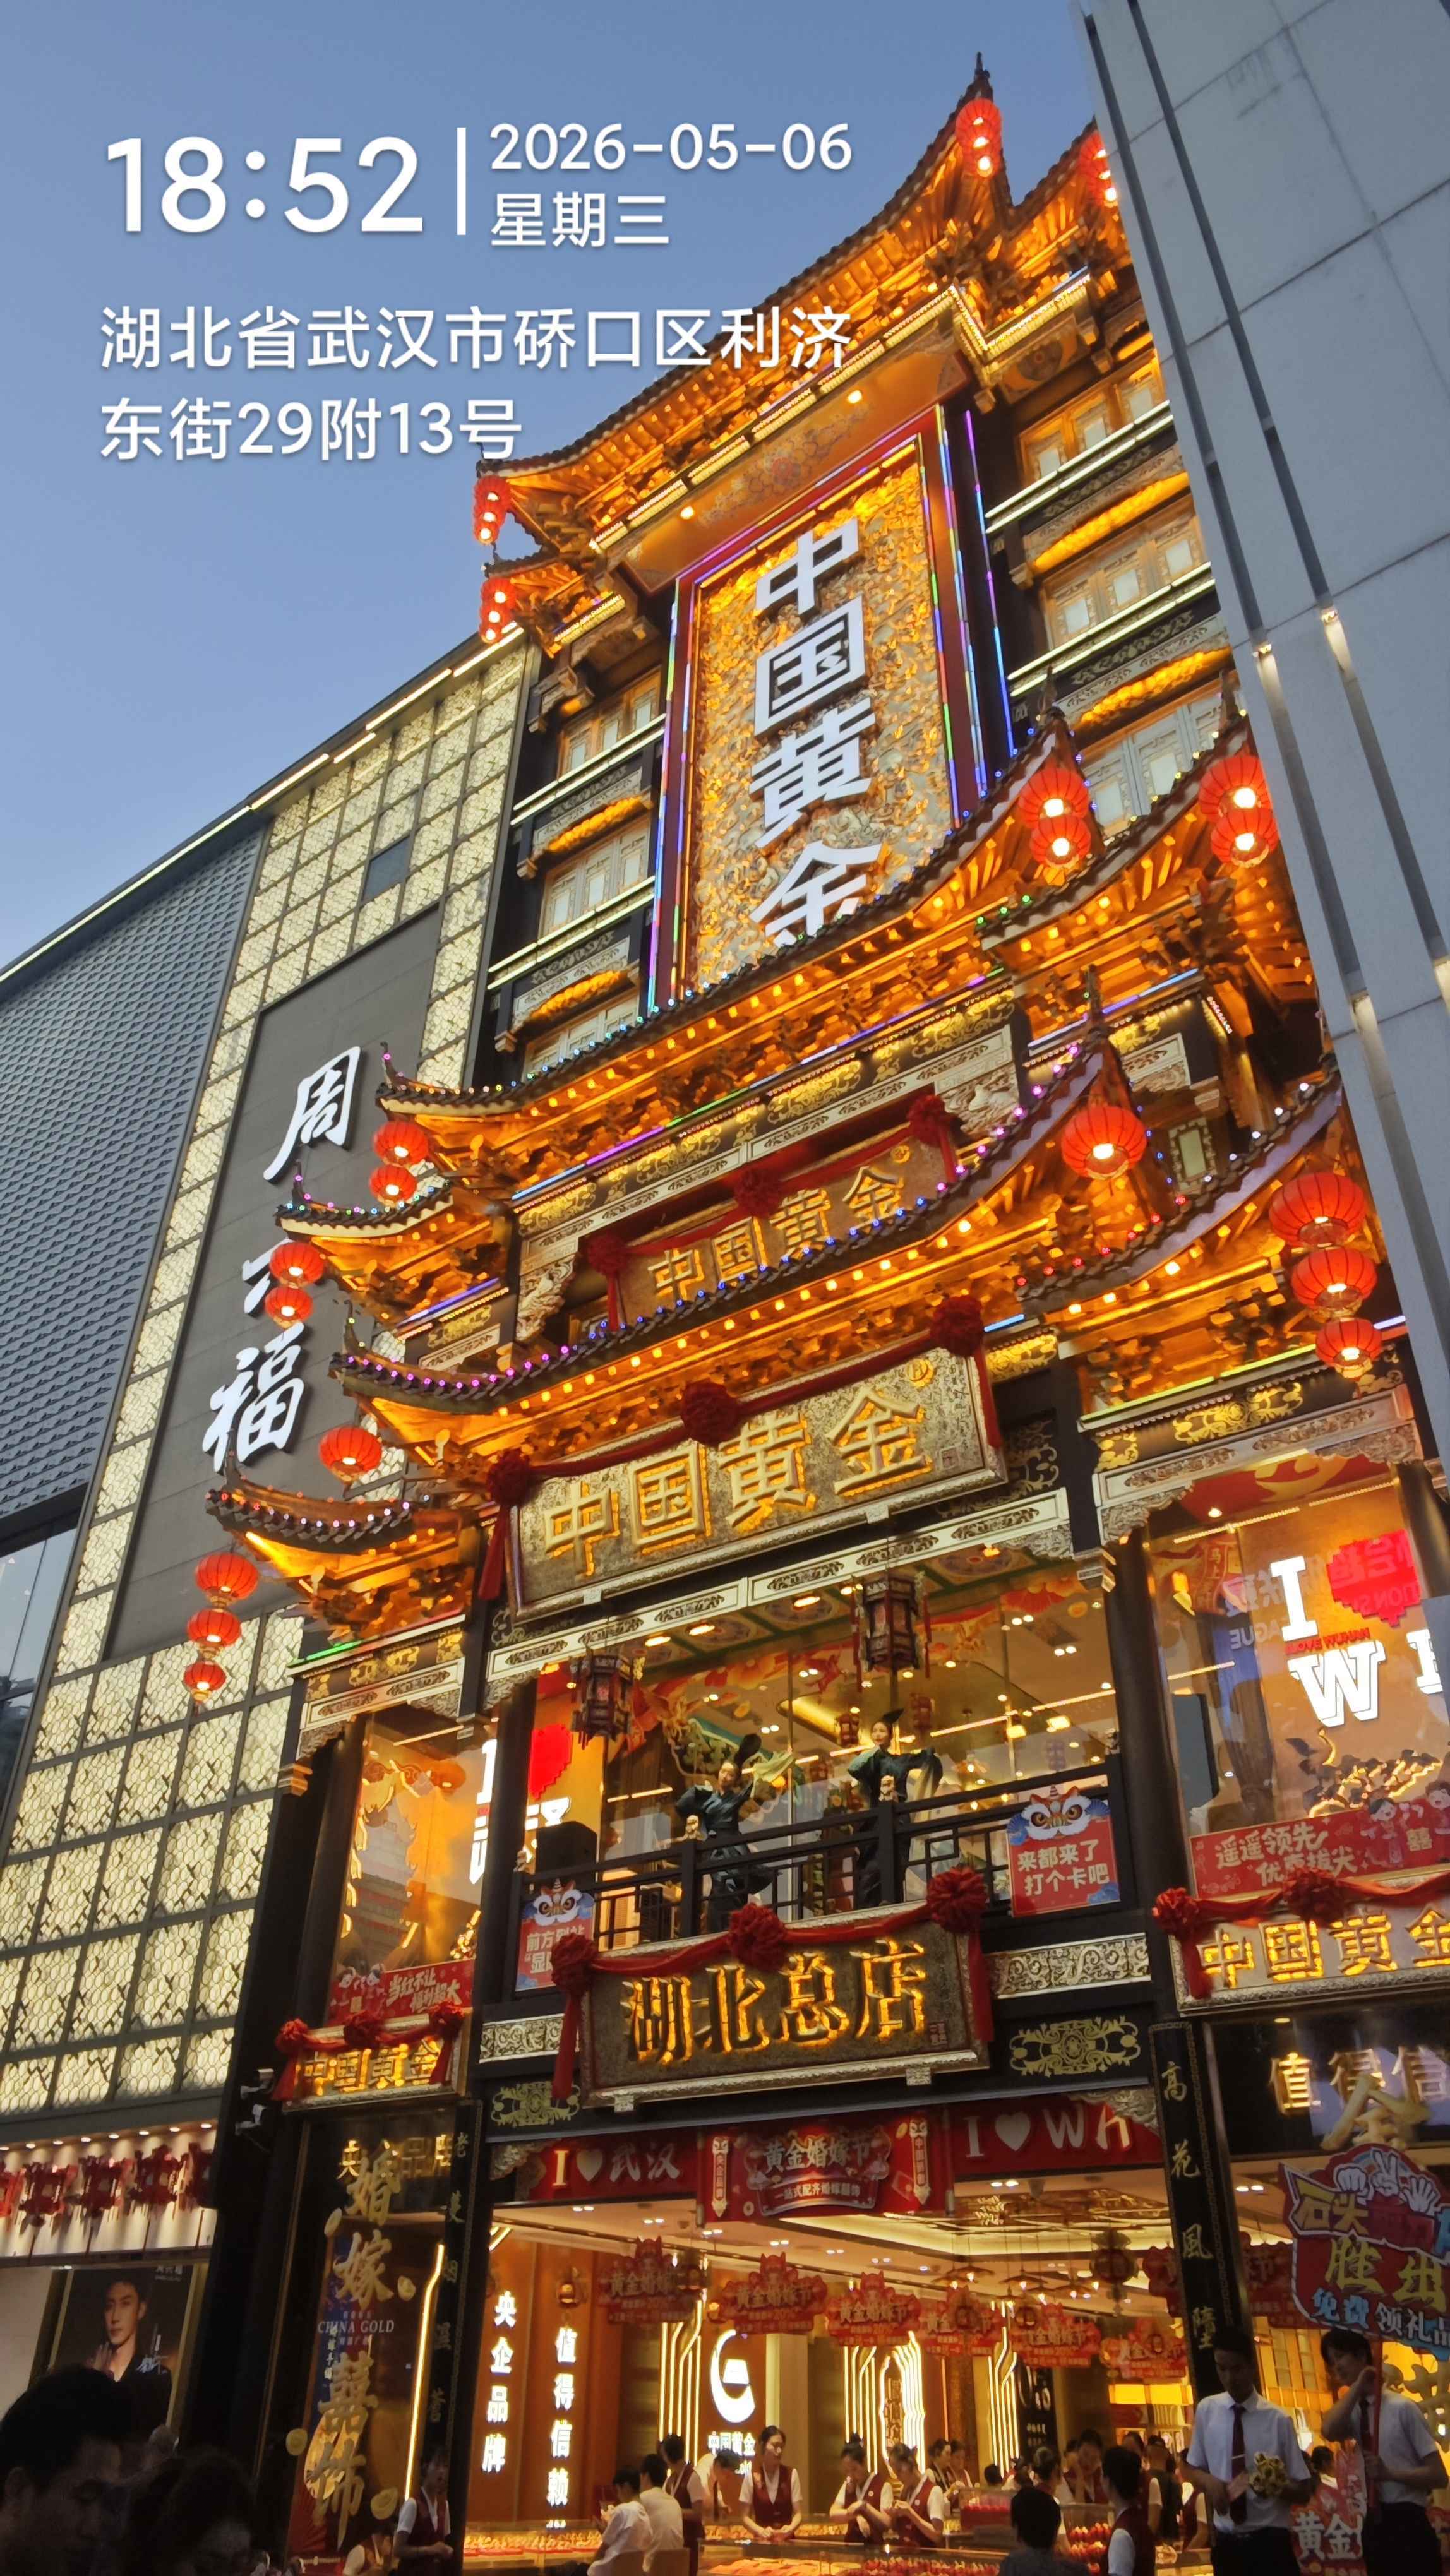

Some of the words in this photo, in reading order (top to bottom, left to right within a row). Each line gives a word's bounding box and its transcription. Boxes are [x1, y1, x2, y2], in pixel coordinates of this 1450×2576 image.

[750, 518, 882, 945] 中国黄金
[203, 1046, 361, 1472] 周福
[647, 1166, 904, 1302] 中国黄金
[544, 1386, 933, 1578] 中国黄金
[1017, 1838, 1099, 1873] 来都来了
[1024, 1863, 1110, 1897] 打个卡吧
[1214, 1822, 1328, 1869] 遥遥领先
[1197, 1903, 1450, 1989] 中国黄金
[621, 1938, 926, 2065] 湖北总店
[303, 2039, 441, 2097] 中国黄金
[764, 2132, 870, 2173] 黄金婚嫁节
[360, 2319, 395, 2334] GOLD
[482, 2289, 517, 2473] 央企品牌
